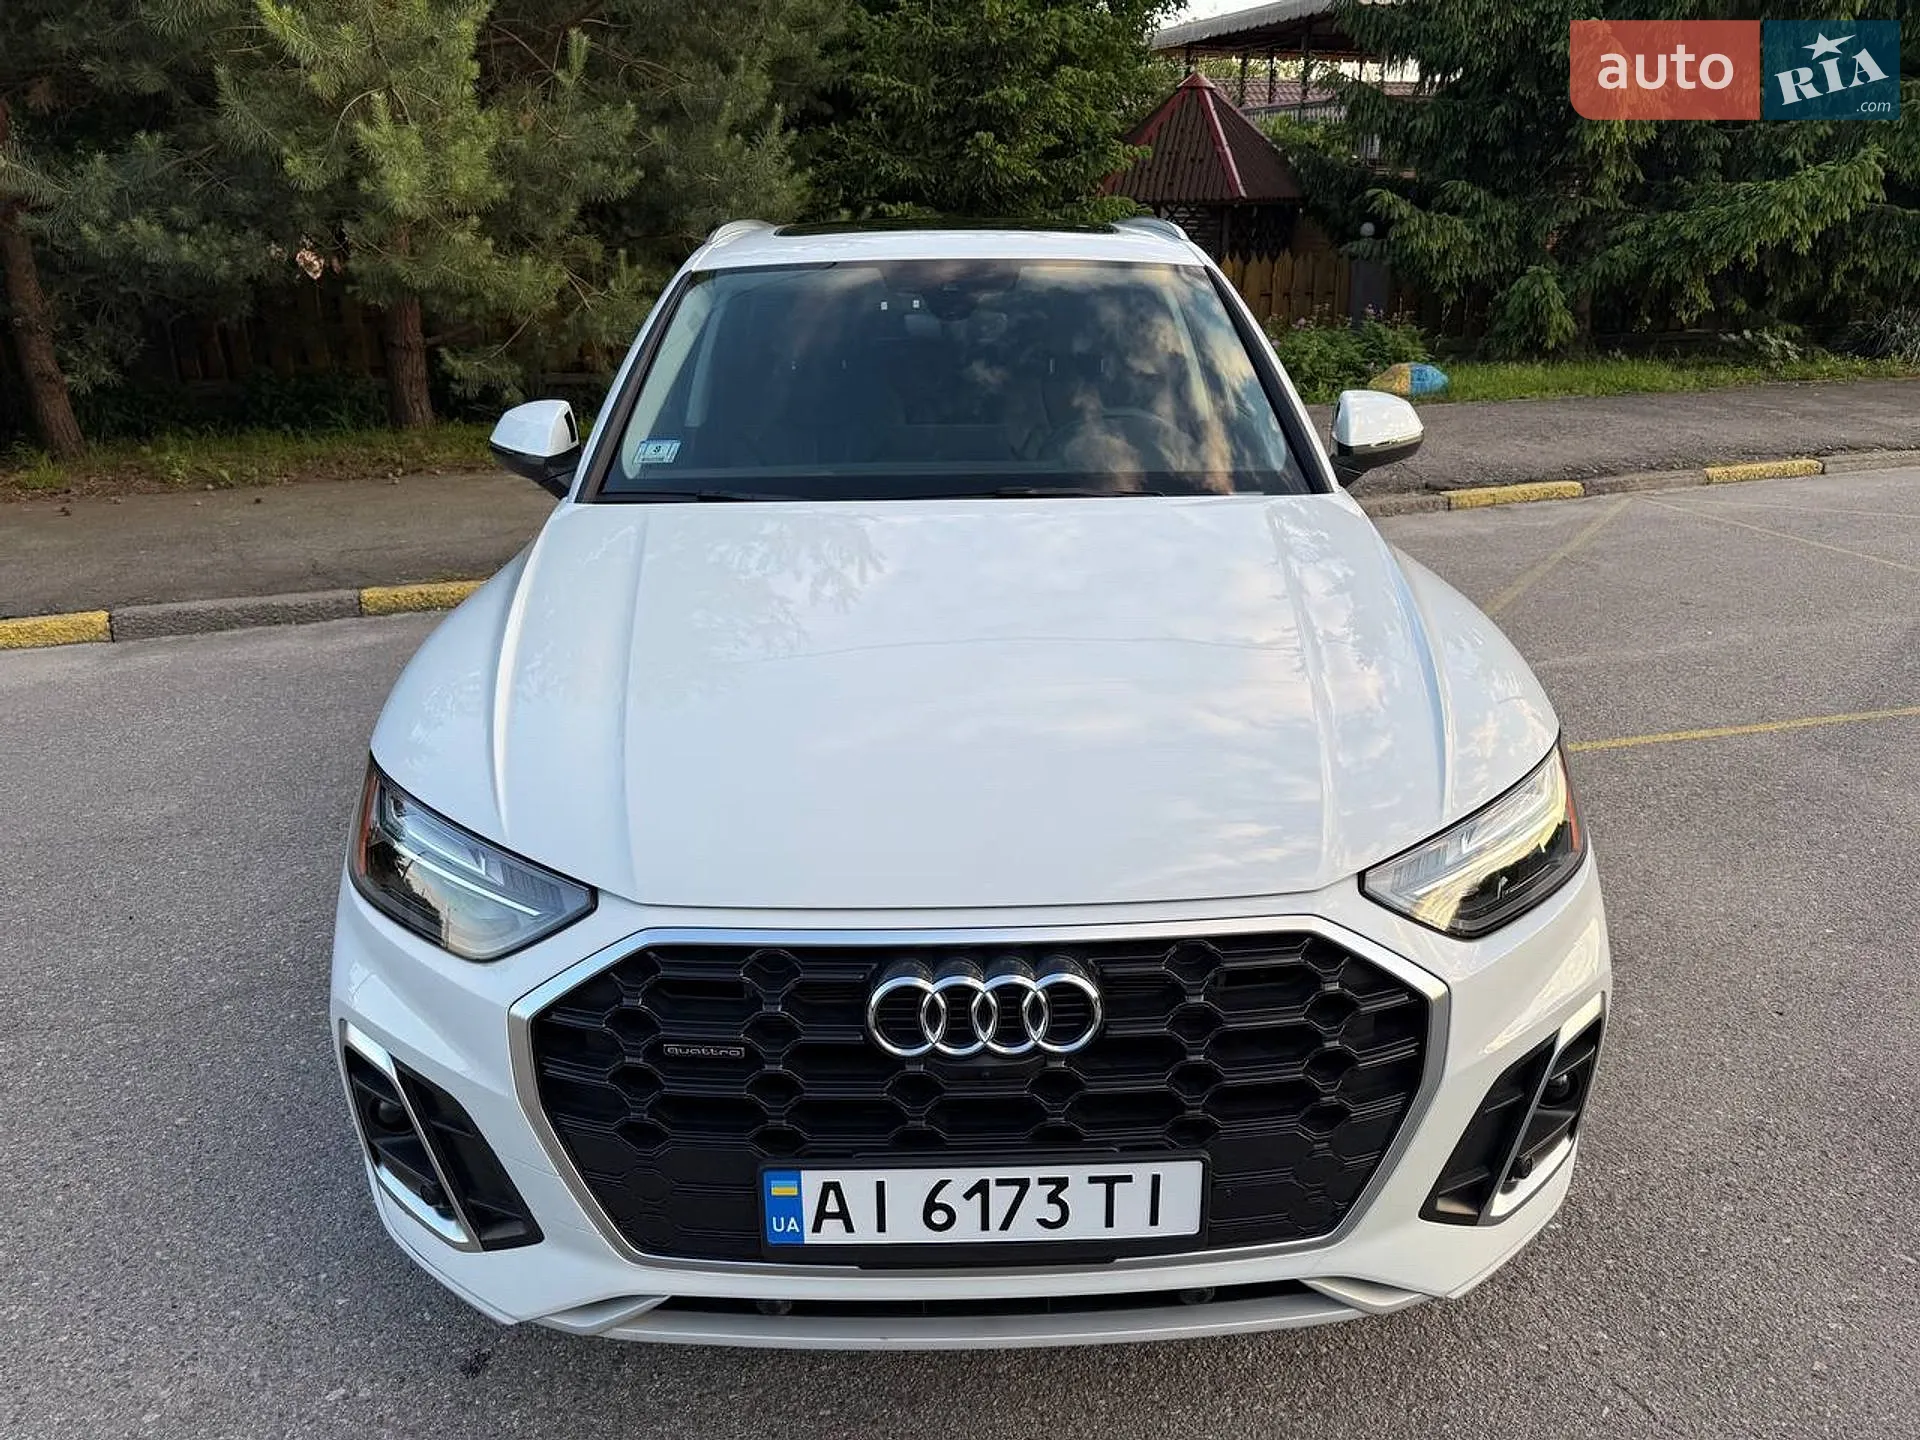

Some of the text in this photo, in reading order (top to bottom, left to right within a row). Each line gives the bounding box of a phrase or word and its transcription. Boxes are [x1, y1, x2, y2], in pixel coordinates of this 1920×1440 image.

[667, 1046, 741, 1057] quattro
[811, 1173, 1162, 1234] AI 6173 TI
[772, 1217, 800, 1233] UA
